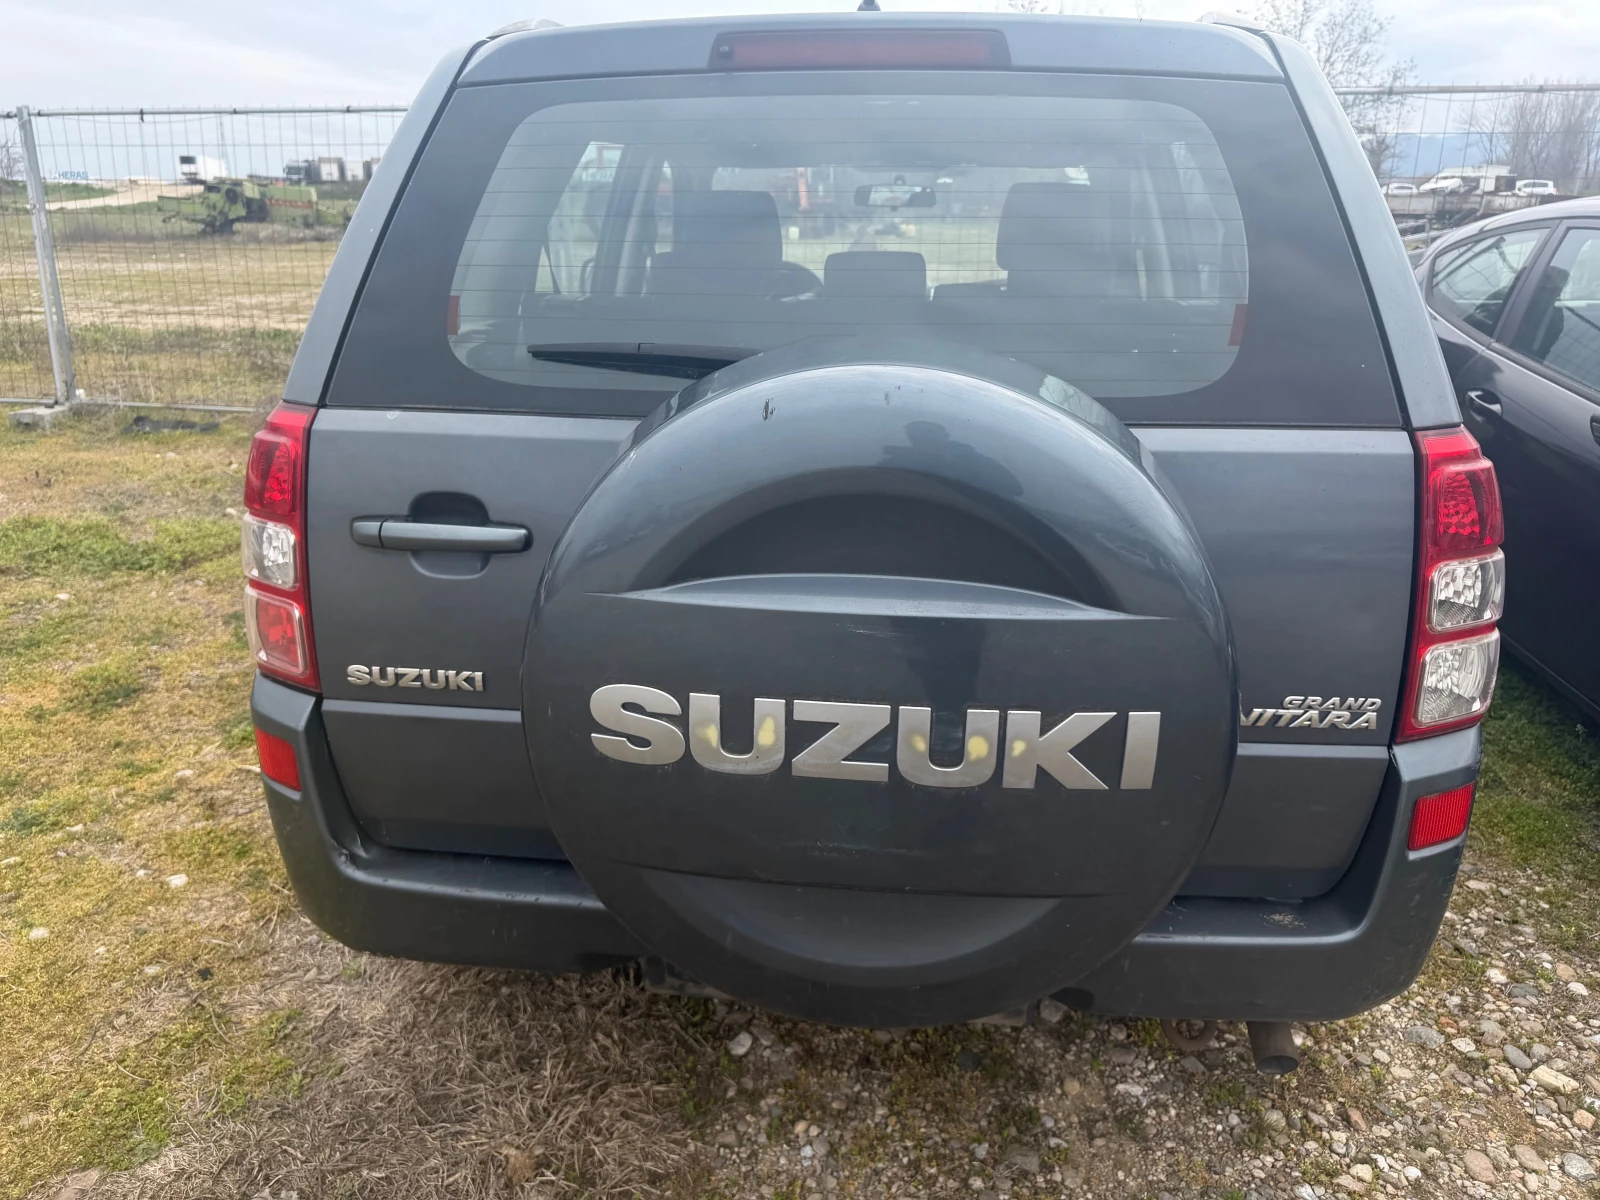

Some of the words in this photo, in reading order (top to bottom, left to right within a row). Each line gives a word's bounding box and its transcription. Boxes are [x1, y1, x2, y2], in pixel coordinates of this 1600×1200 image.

[58, 170, 89, 179] HERAS
[347, 664, 484, 691] SUZUKI
[1282, 695, 1381, 710] GRAND
[590, 683, 1161, 790] SUZUKI
